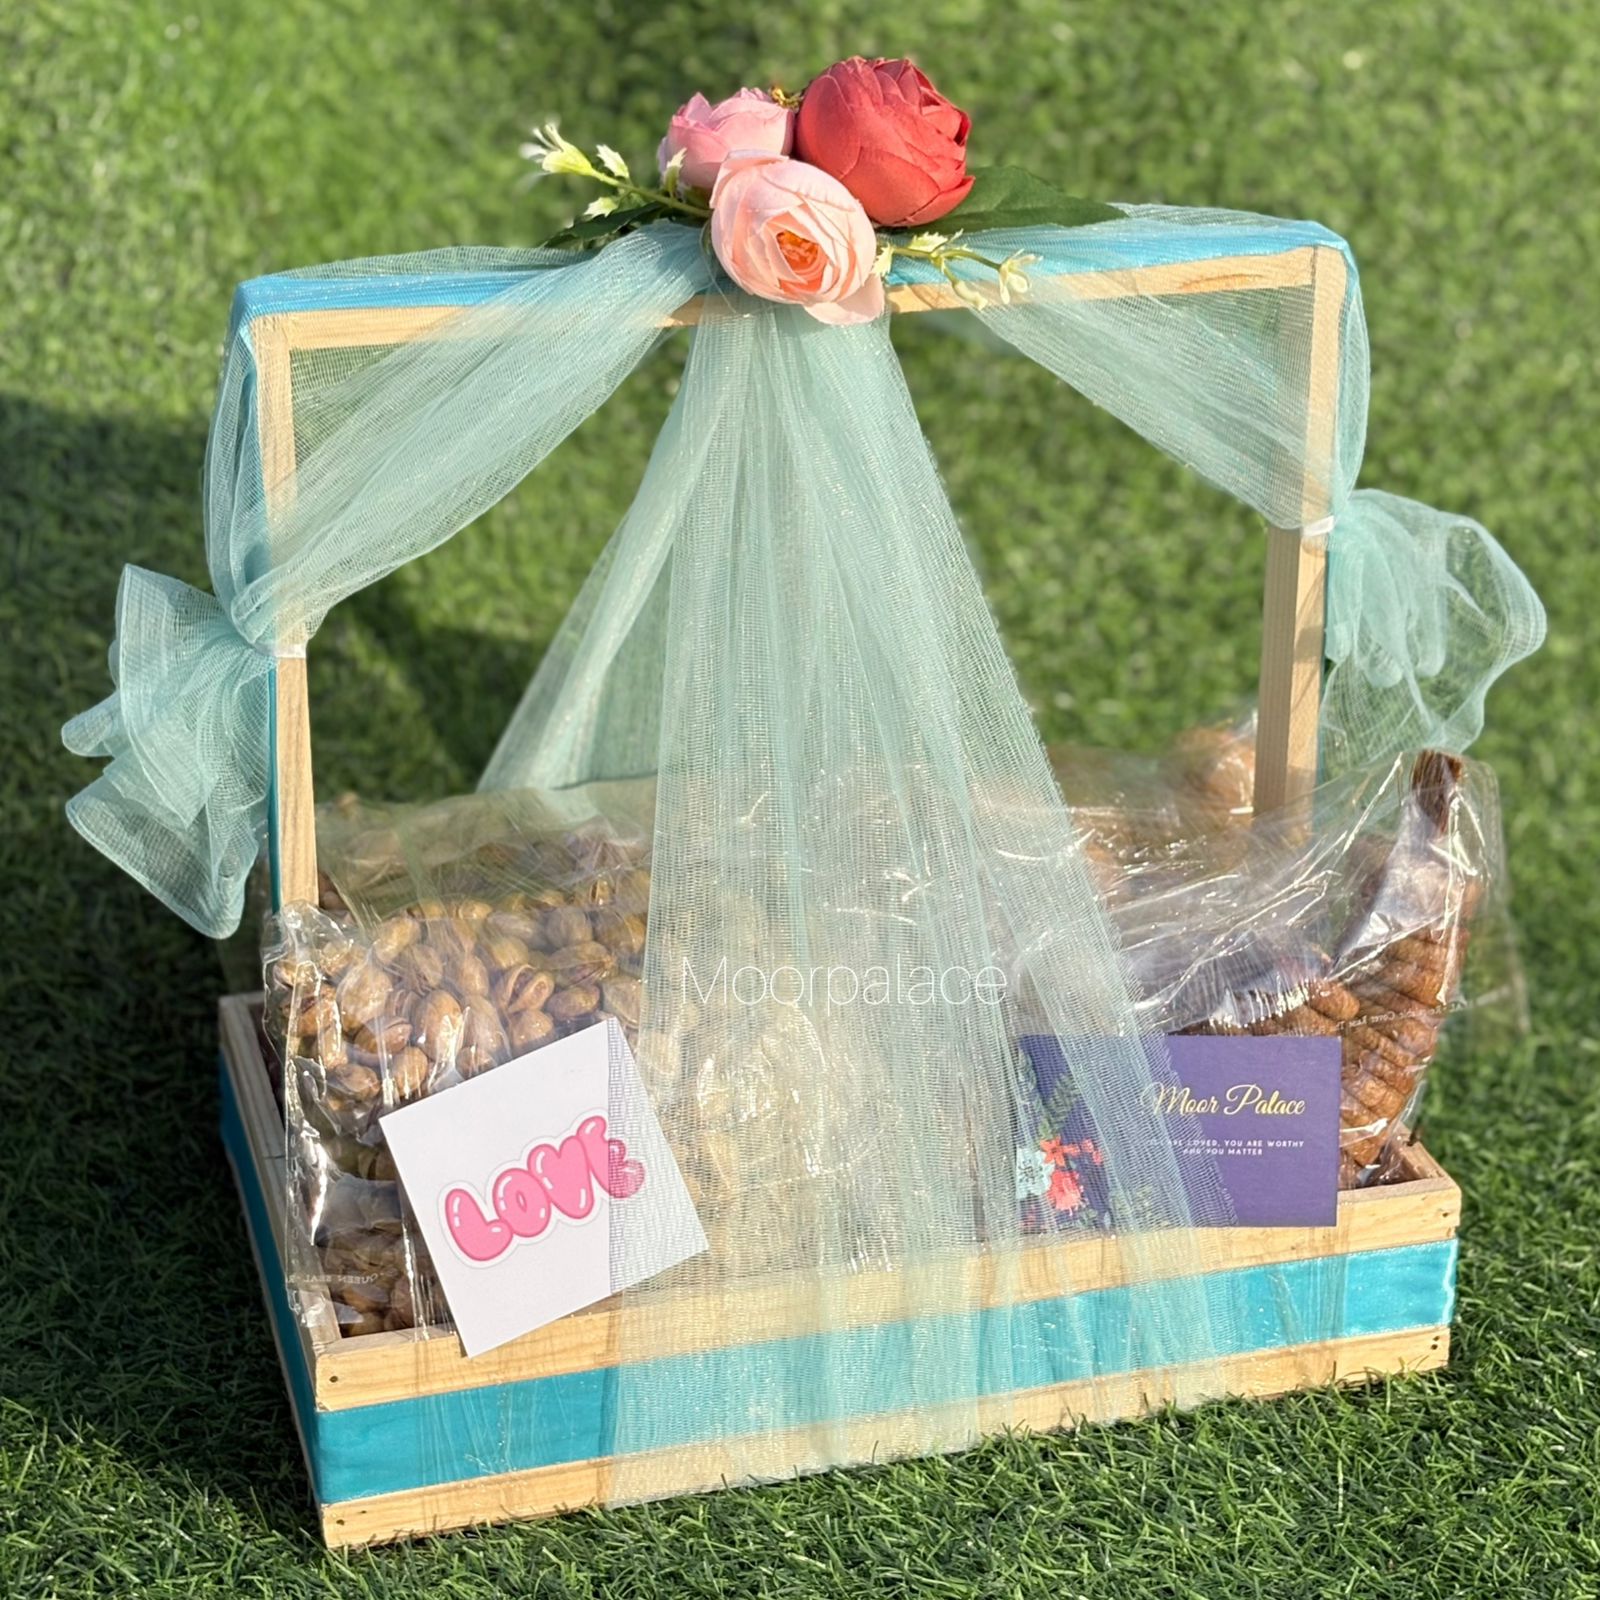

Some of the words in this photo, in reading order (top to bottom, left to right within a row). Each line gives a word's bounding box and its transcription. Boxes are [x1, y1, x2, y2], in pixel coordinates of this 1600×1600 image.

[1140, 1081, 1219, 1116] Moor
[1223, 1084, 1306, 1116] Palace
[1227, 1148, 1263, 1156] MATTER
[1267, 1140, 1304, 1148] WORTHY
[445, 1115, 645, 1261] LOVE
